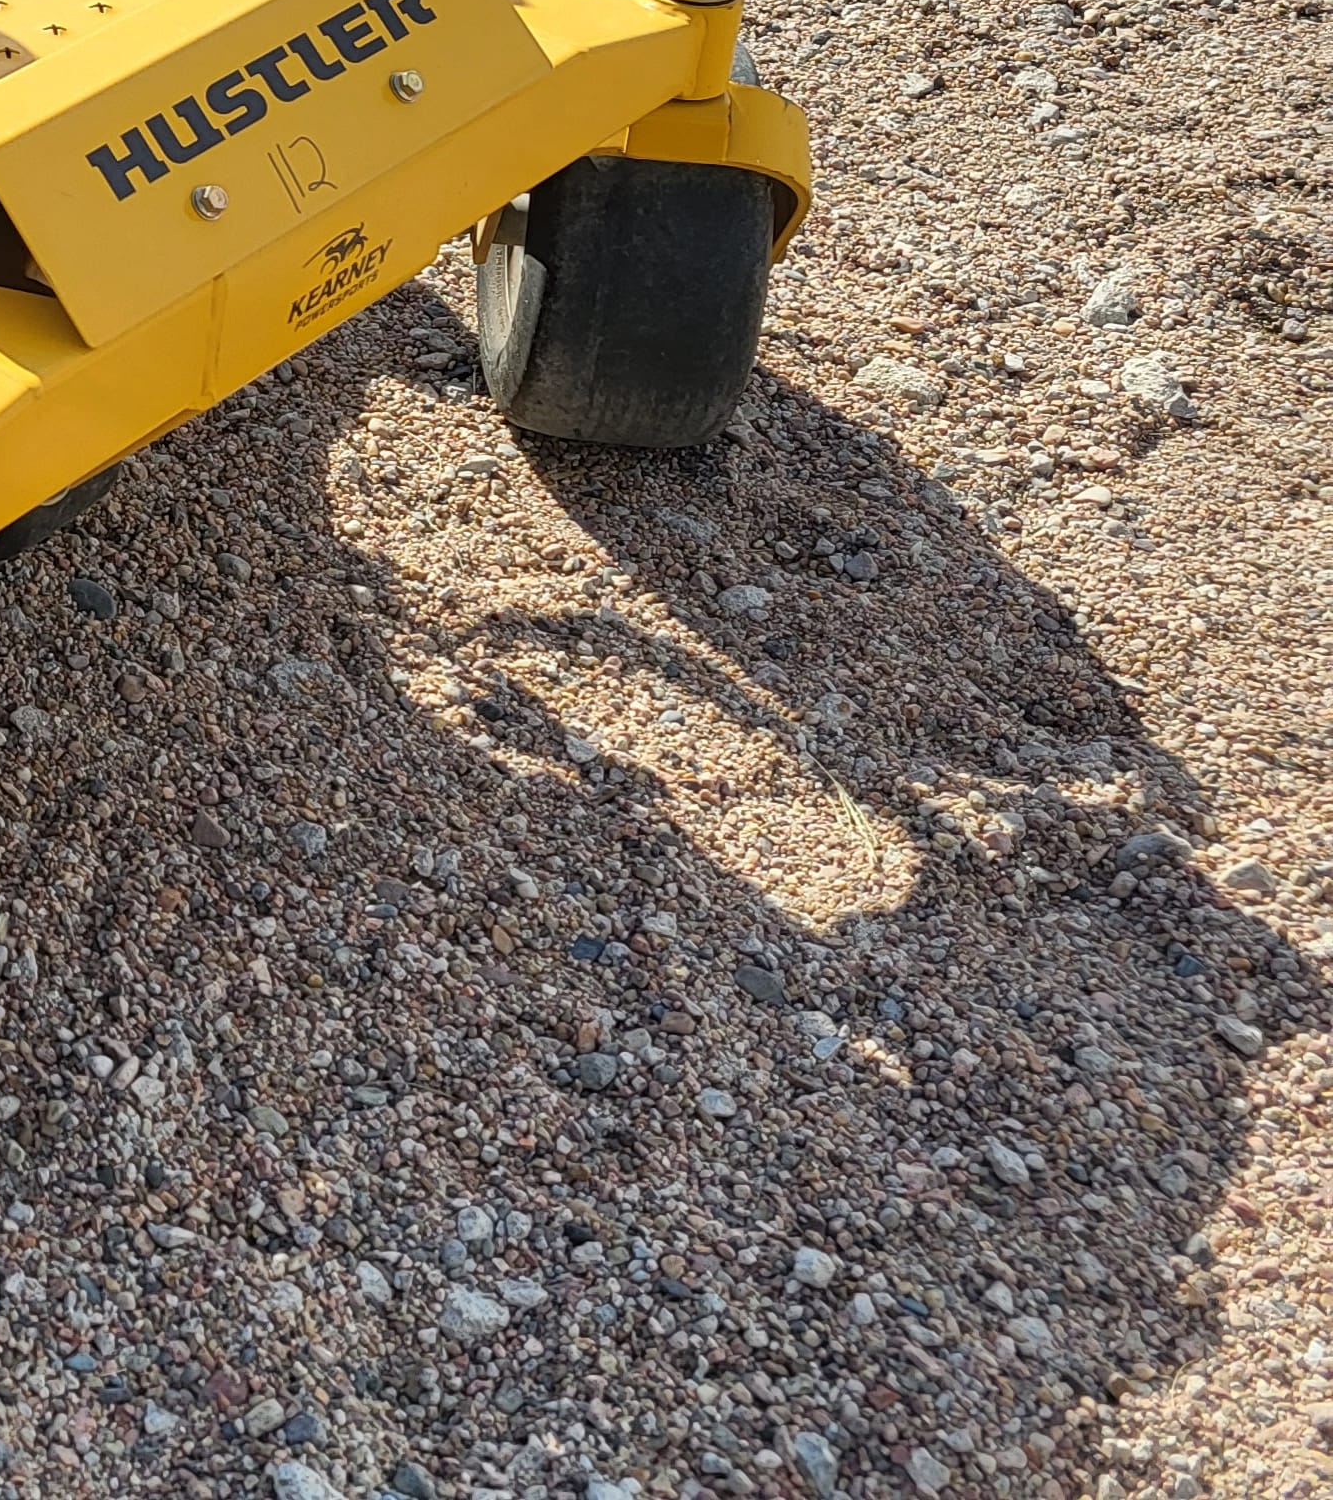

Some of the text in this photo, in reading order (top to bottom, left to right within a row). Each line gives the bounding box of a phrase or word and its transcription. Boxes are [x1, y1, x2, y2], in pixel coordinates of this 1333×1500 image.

[267, 135, 338, 214] 112
[287, 237, 393, 325] KEARNEY
[293, 269, 380, 332] POWERSPORTS
